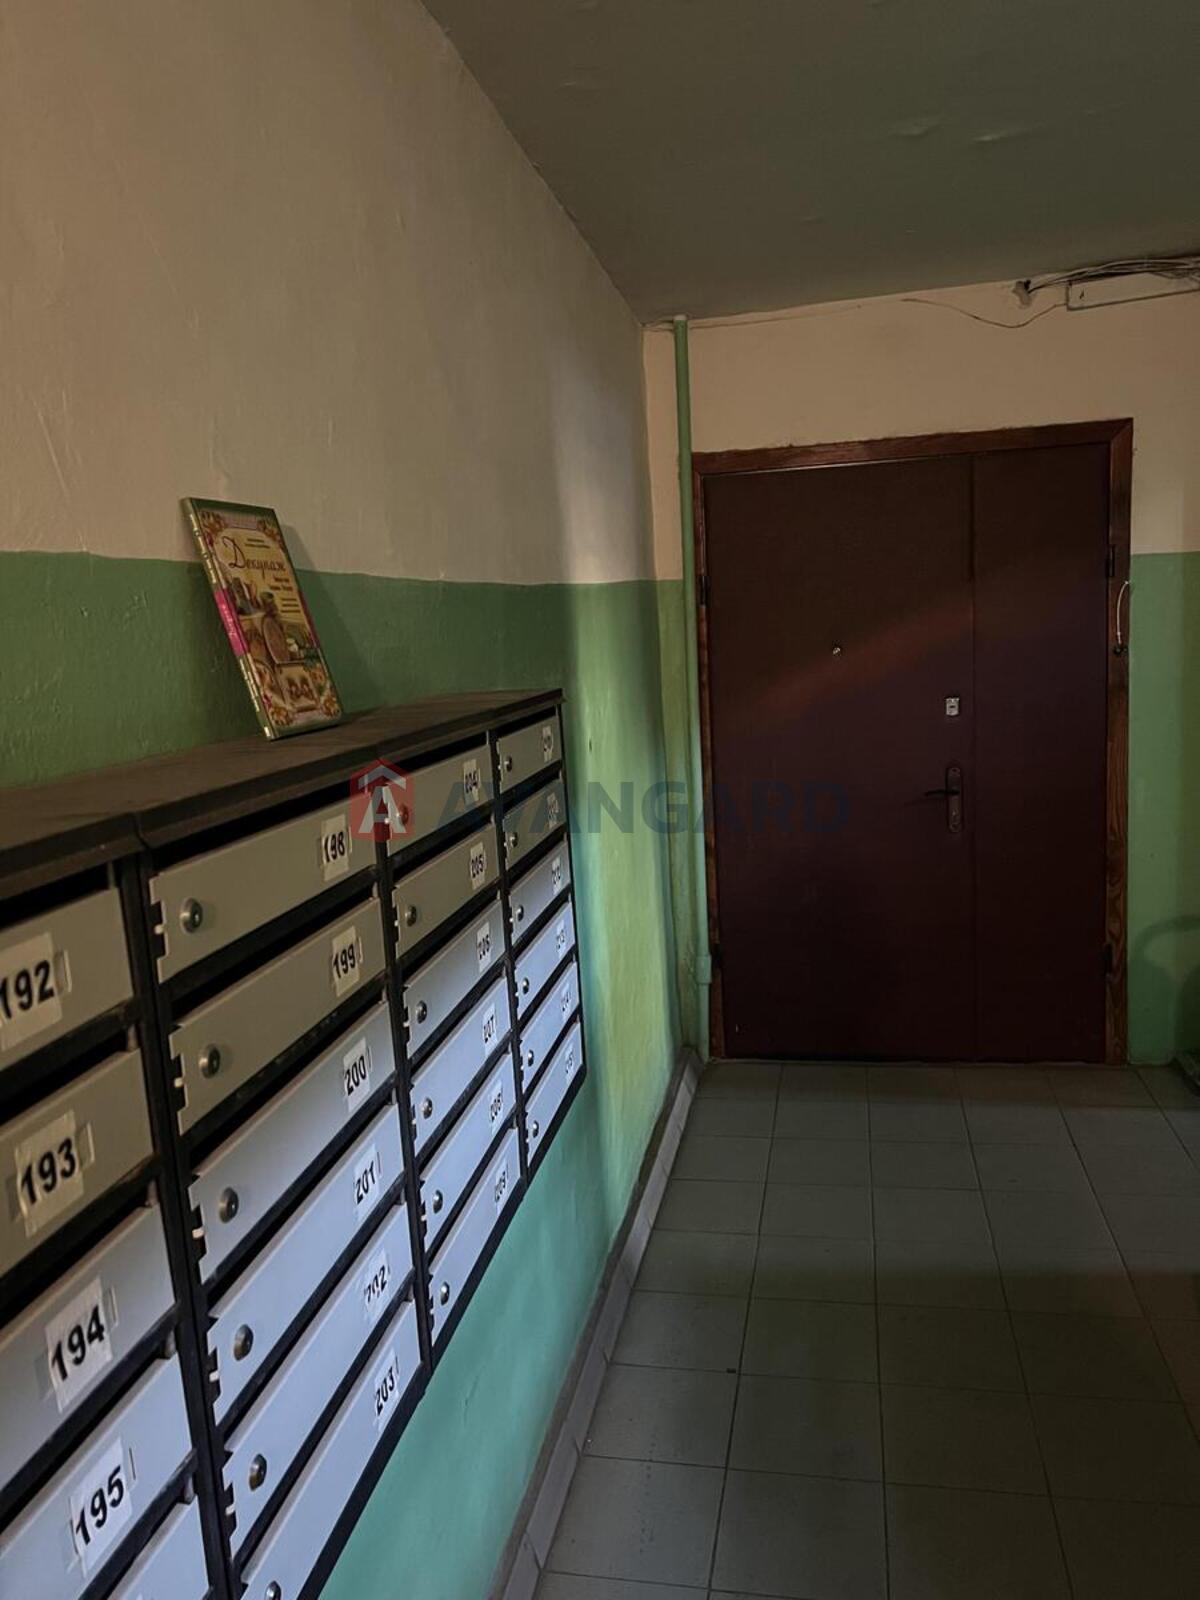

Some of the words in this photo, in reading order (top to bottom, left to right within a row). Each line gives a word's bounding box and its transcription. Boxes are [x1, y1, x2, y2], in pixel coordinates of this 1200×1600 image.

[323, 831, 346, 864] 198
[333, 945, 356, 979] 199
[0, 960, 55, 1018] 192
[344, 1056, 367, 1096] 200
[21, 1138, 77, 1205] 193
[354, 1161, 377, 1205] 201
[51, 1305, 105, 1381] 194
[375, 1369, 396, 1415] 203
[75, 1465, 124, 1545] 195
